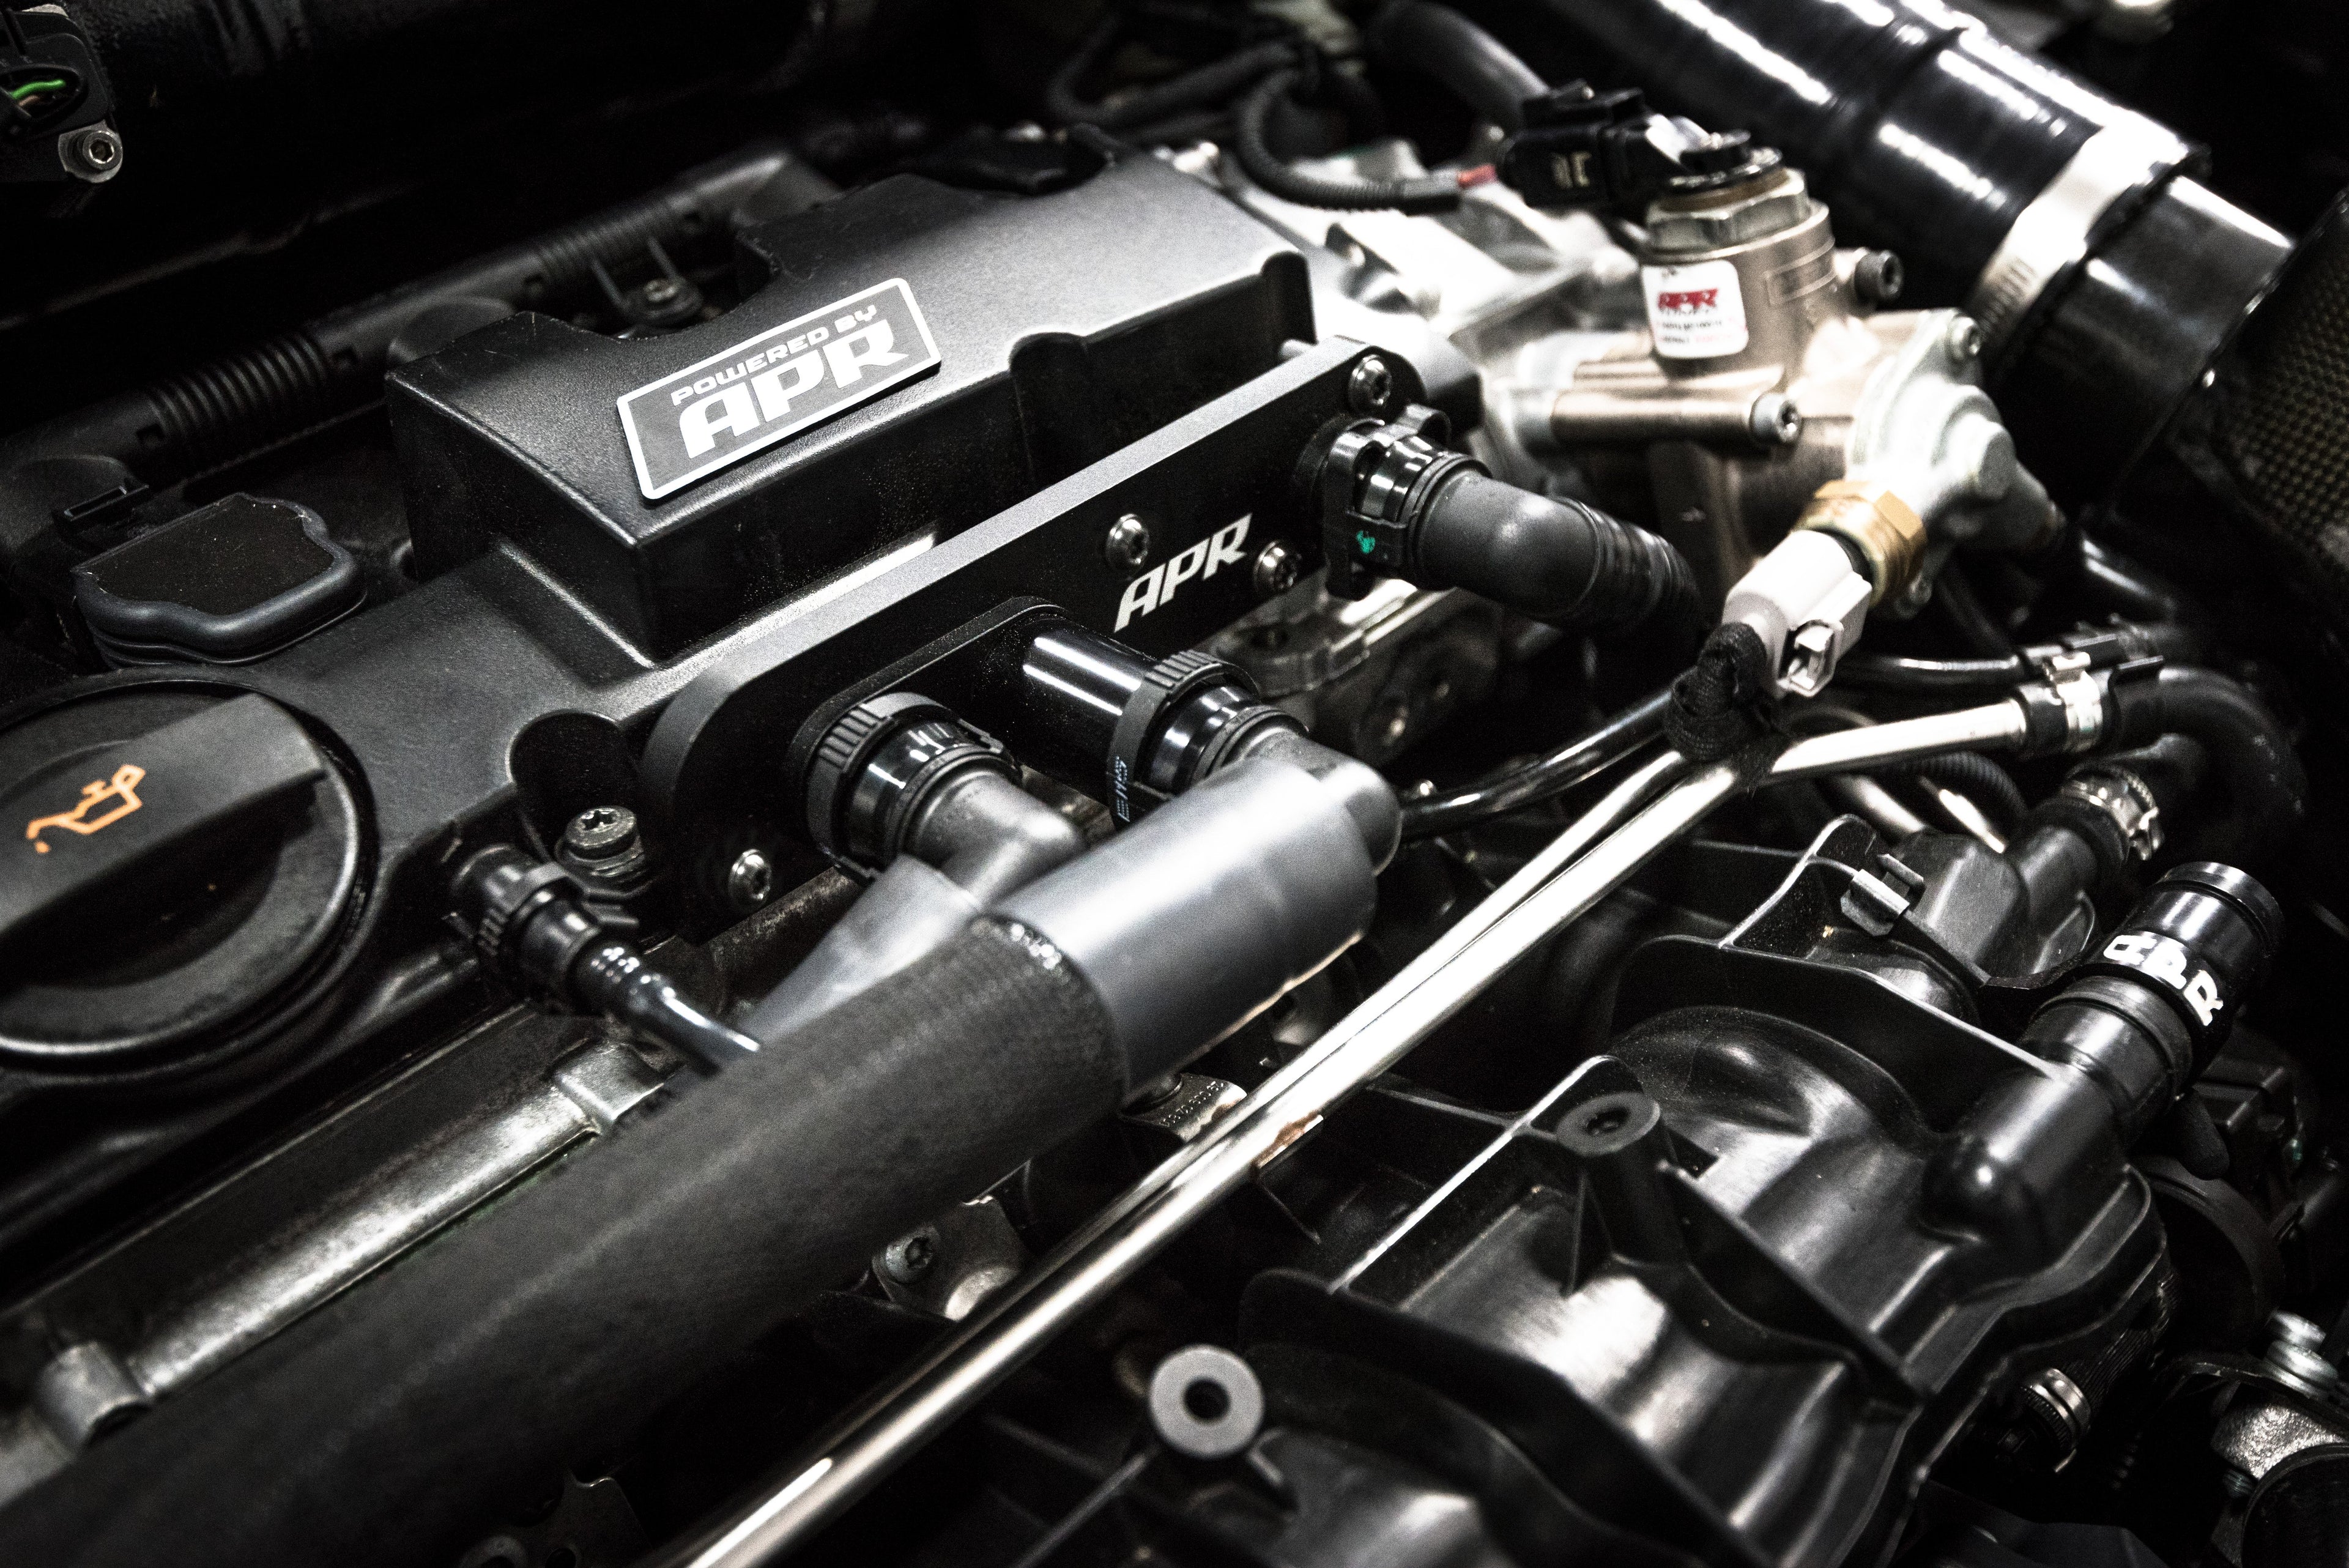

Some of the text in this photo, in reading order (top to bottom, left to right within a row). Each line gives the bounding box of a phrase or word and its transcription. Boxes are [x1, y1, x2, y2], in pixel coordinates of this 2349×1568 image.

[1657, 288, 1718, 310] APR
[670, 305, 877, 406] POWERED BY
[679, 319, 910, 459] APR
[1113, 512, 1253, 634] APR
[2103, 934, 2224, 1027] APR
